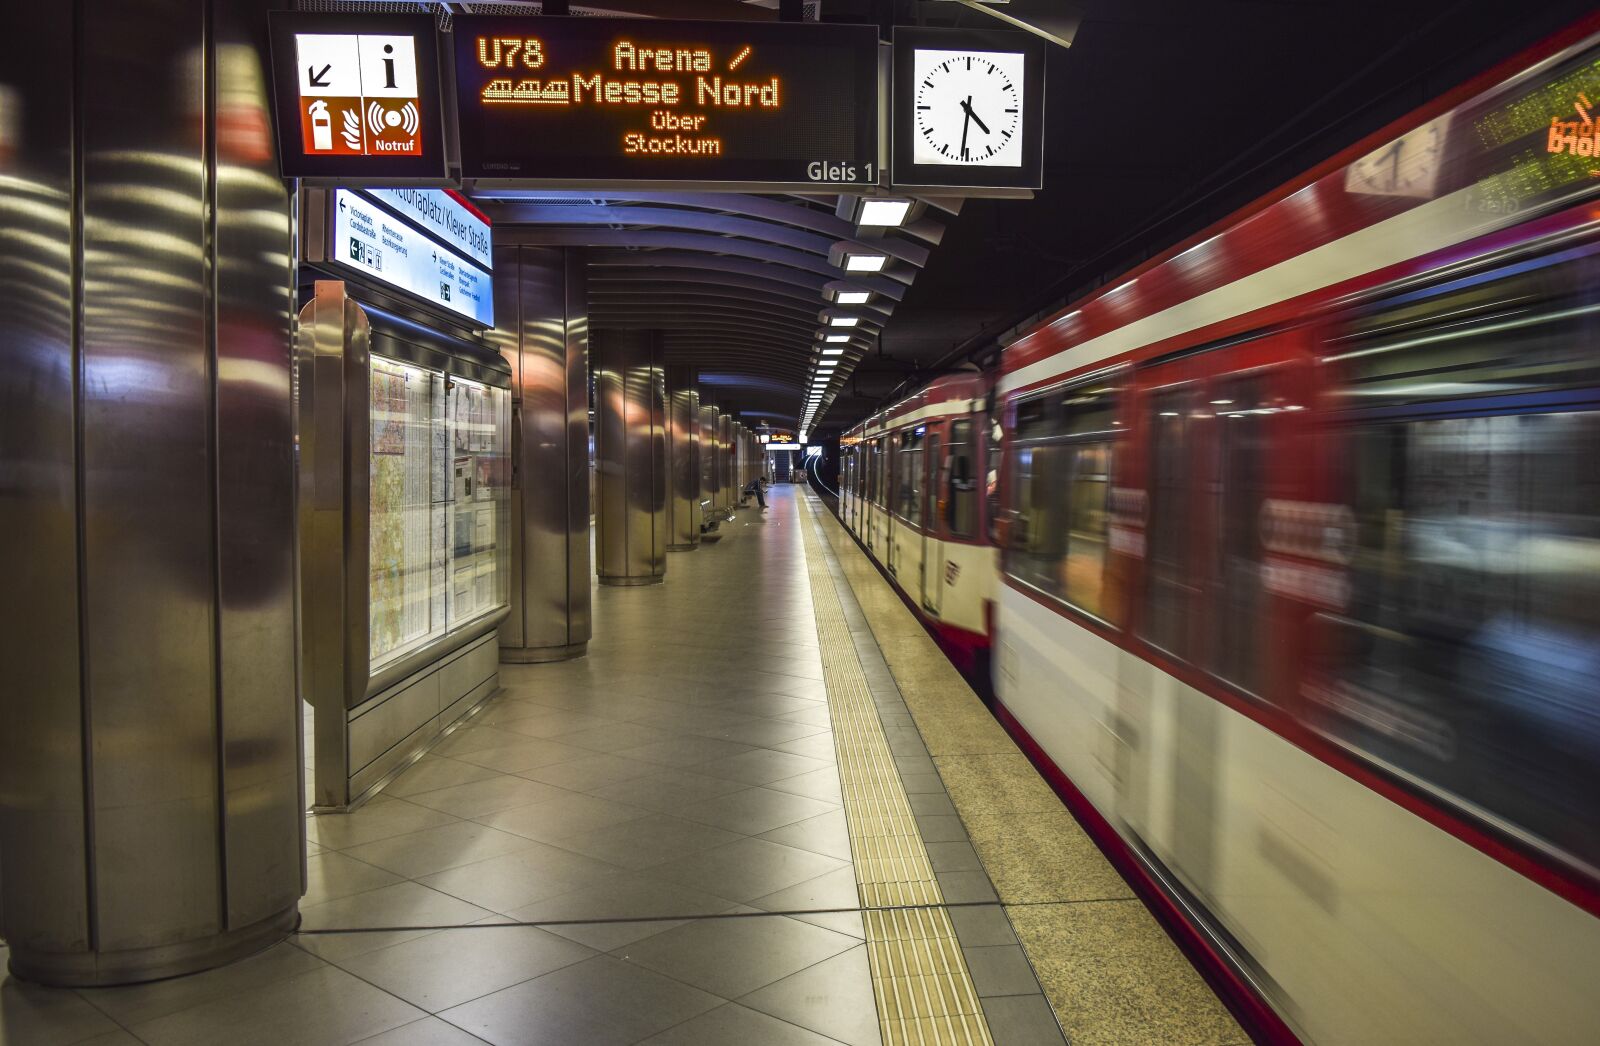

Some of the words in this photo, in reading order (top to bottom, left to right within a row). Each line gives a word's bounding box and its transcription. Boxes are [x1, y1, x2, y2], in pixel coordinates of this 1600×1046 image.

[478, 38, 544, 68] U78
[614, 41, 711, 72] Arena
[729, 46, 750, 70] /
[573, 74, 679, 104] Messe
[697, 76, 778, 107] Nord
[651, 111, 706, 131] über
[375, 139, 415, 151] Notruf
[624, 134, 720, 155] Stockum
[807, 161, 857, 182] Gleis
[864, 163, 873, 182] 1
[468, 224, 488, 256] Straße
